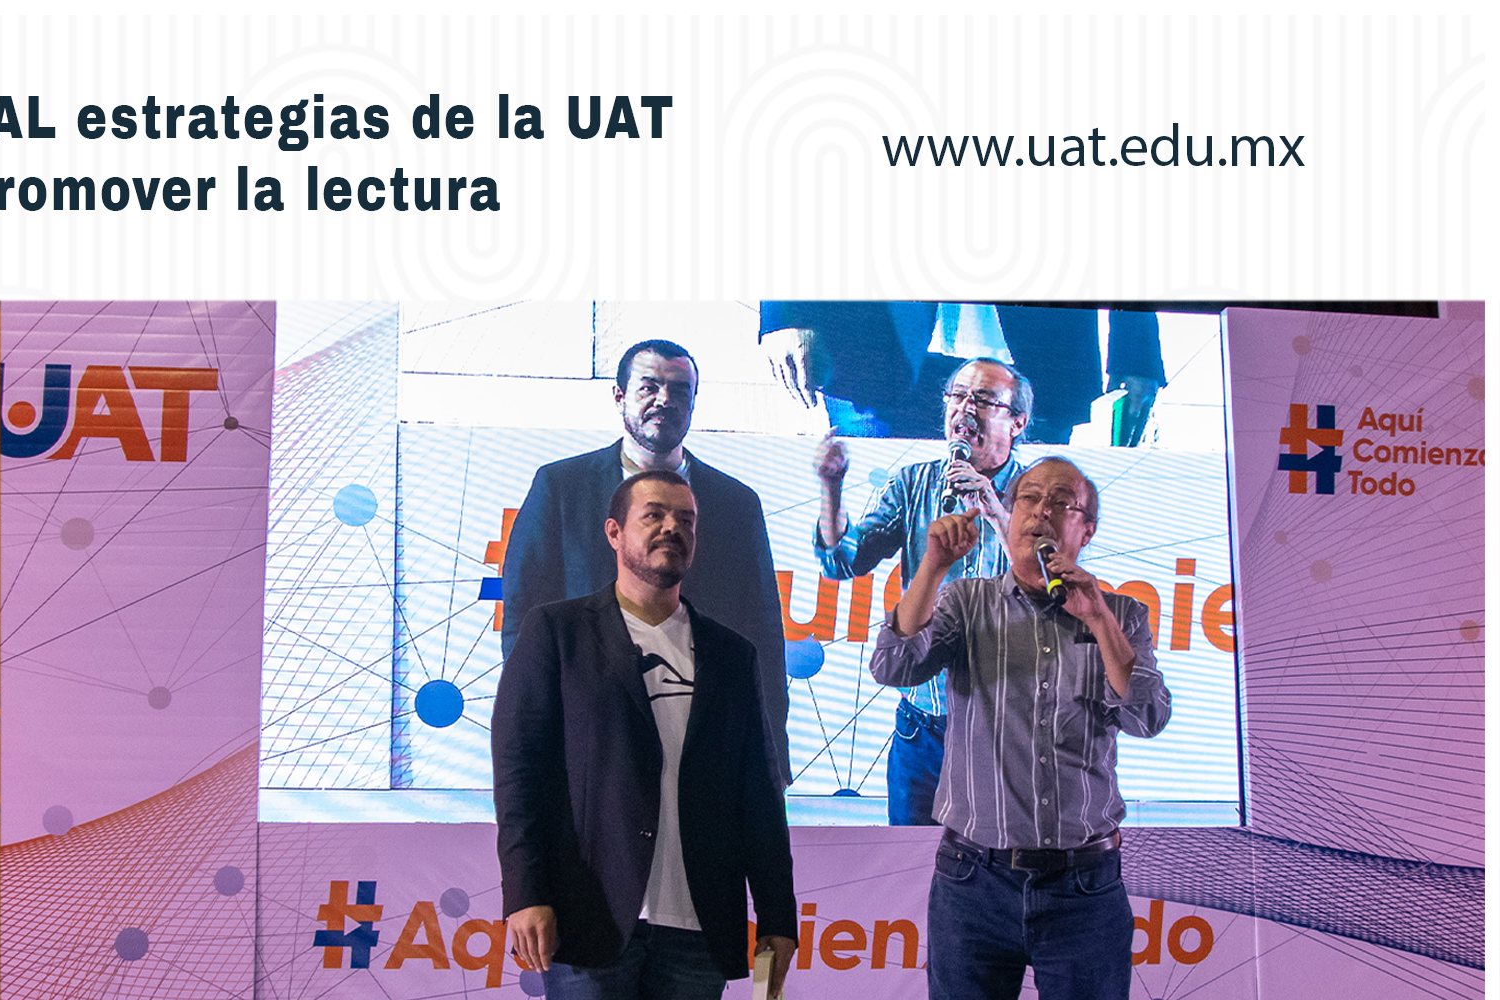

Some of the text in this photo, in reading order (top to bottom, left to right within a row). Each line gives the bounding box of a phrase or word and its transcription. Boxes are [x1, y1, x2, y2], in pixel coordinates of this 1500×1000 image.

[0, 363, 218, 462] UAT
[1357, 407, 1423, 437] Aquí
[1348, 470, 1415, 496] Todo
